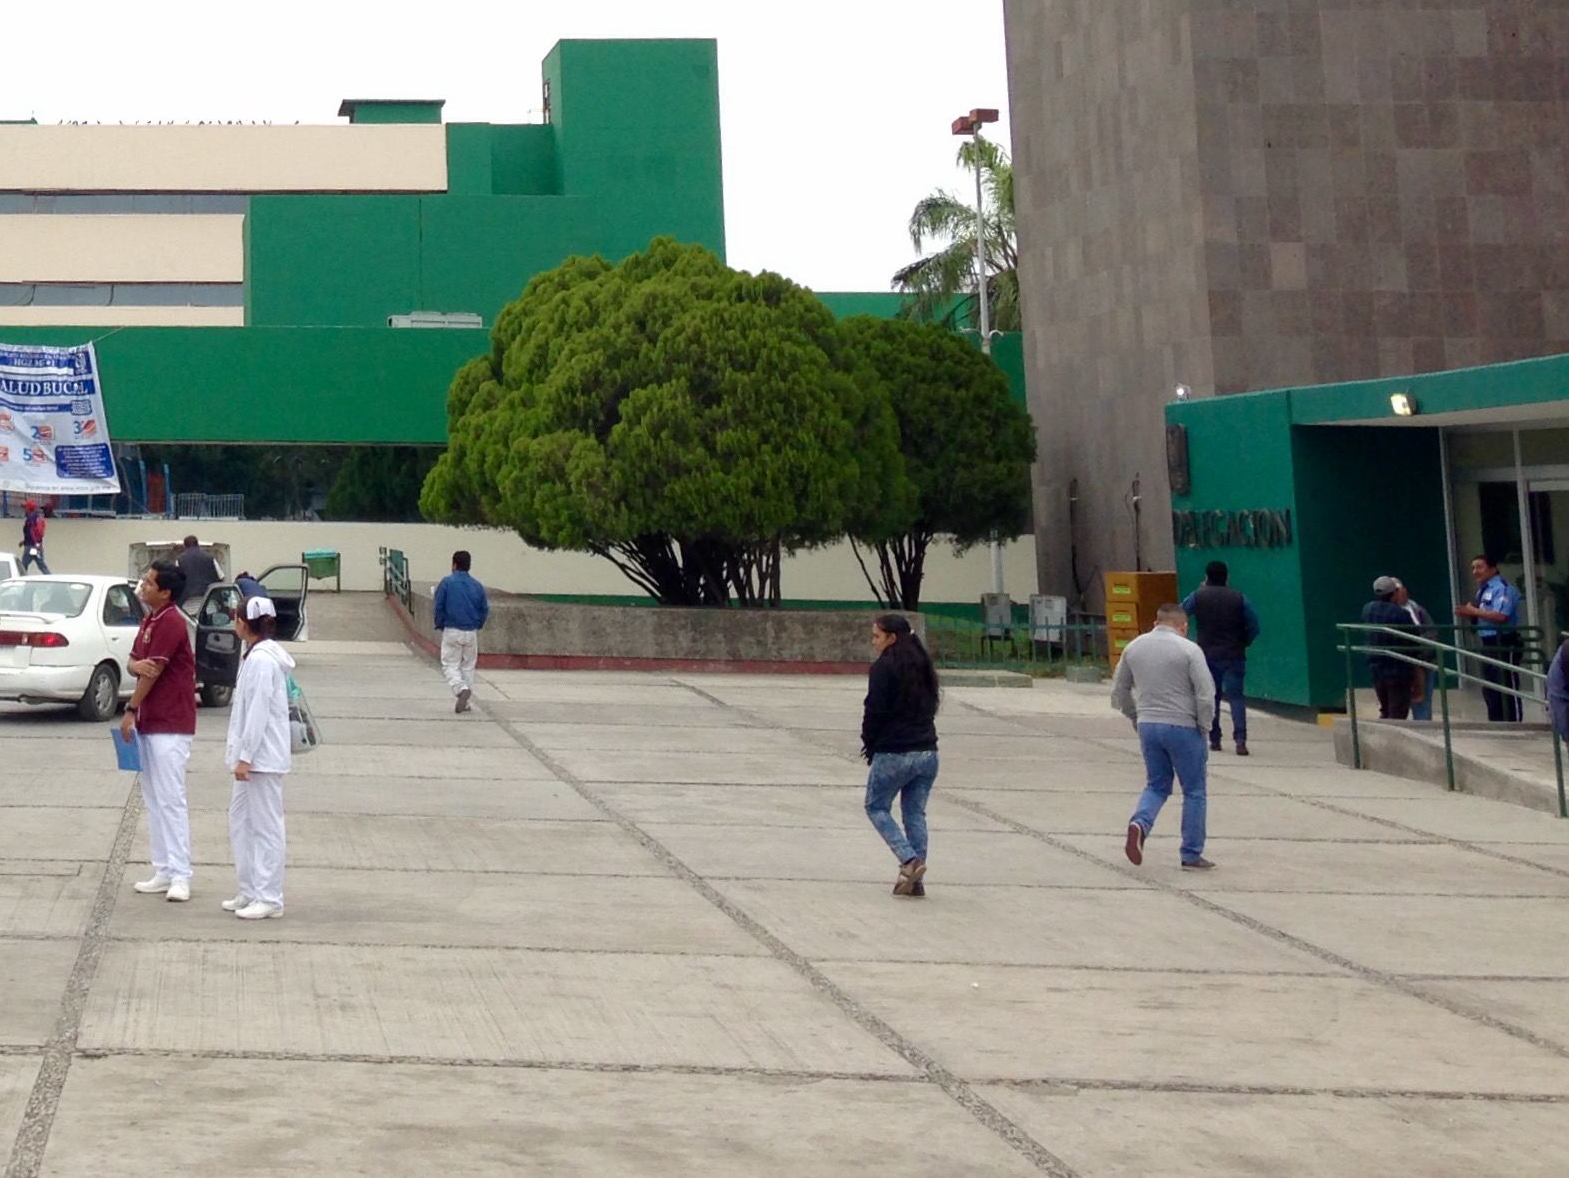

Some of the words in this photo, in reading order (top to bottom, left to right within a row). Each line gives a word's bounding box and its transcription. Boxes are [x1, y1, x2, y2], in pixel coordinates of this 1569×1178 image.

[43, 380, 88, 396] BUCAL
[31, 425, 40, 441] 2
[73, 420, 82, 434] 3
[23, 447, 32, 462] 5
